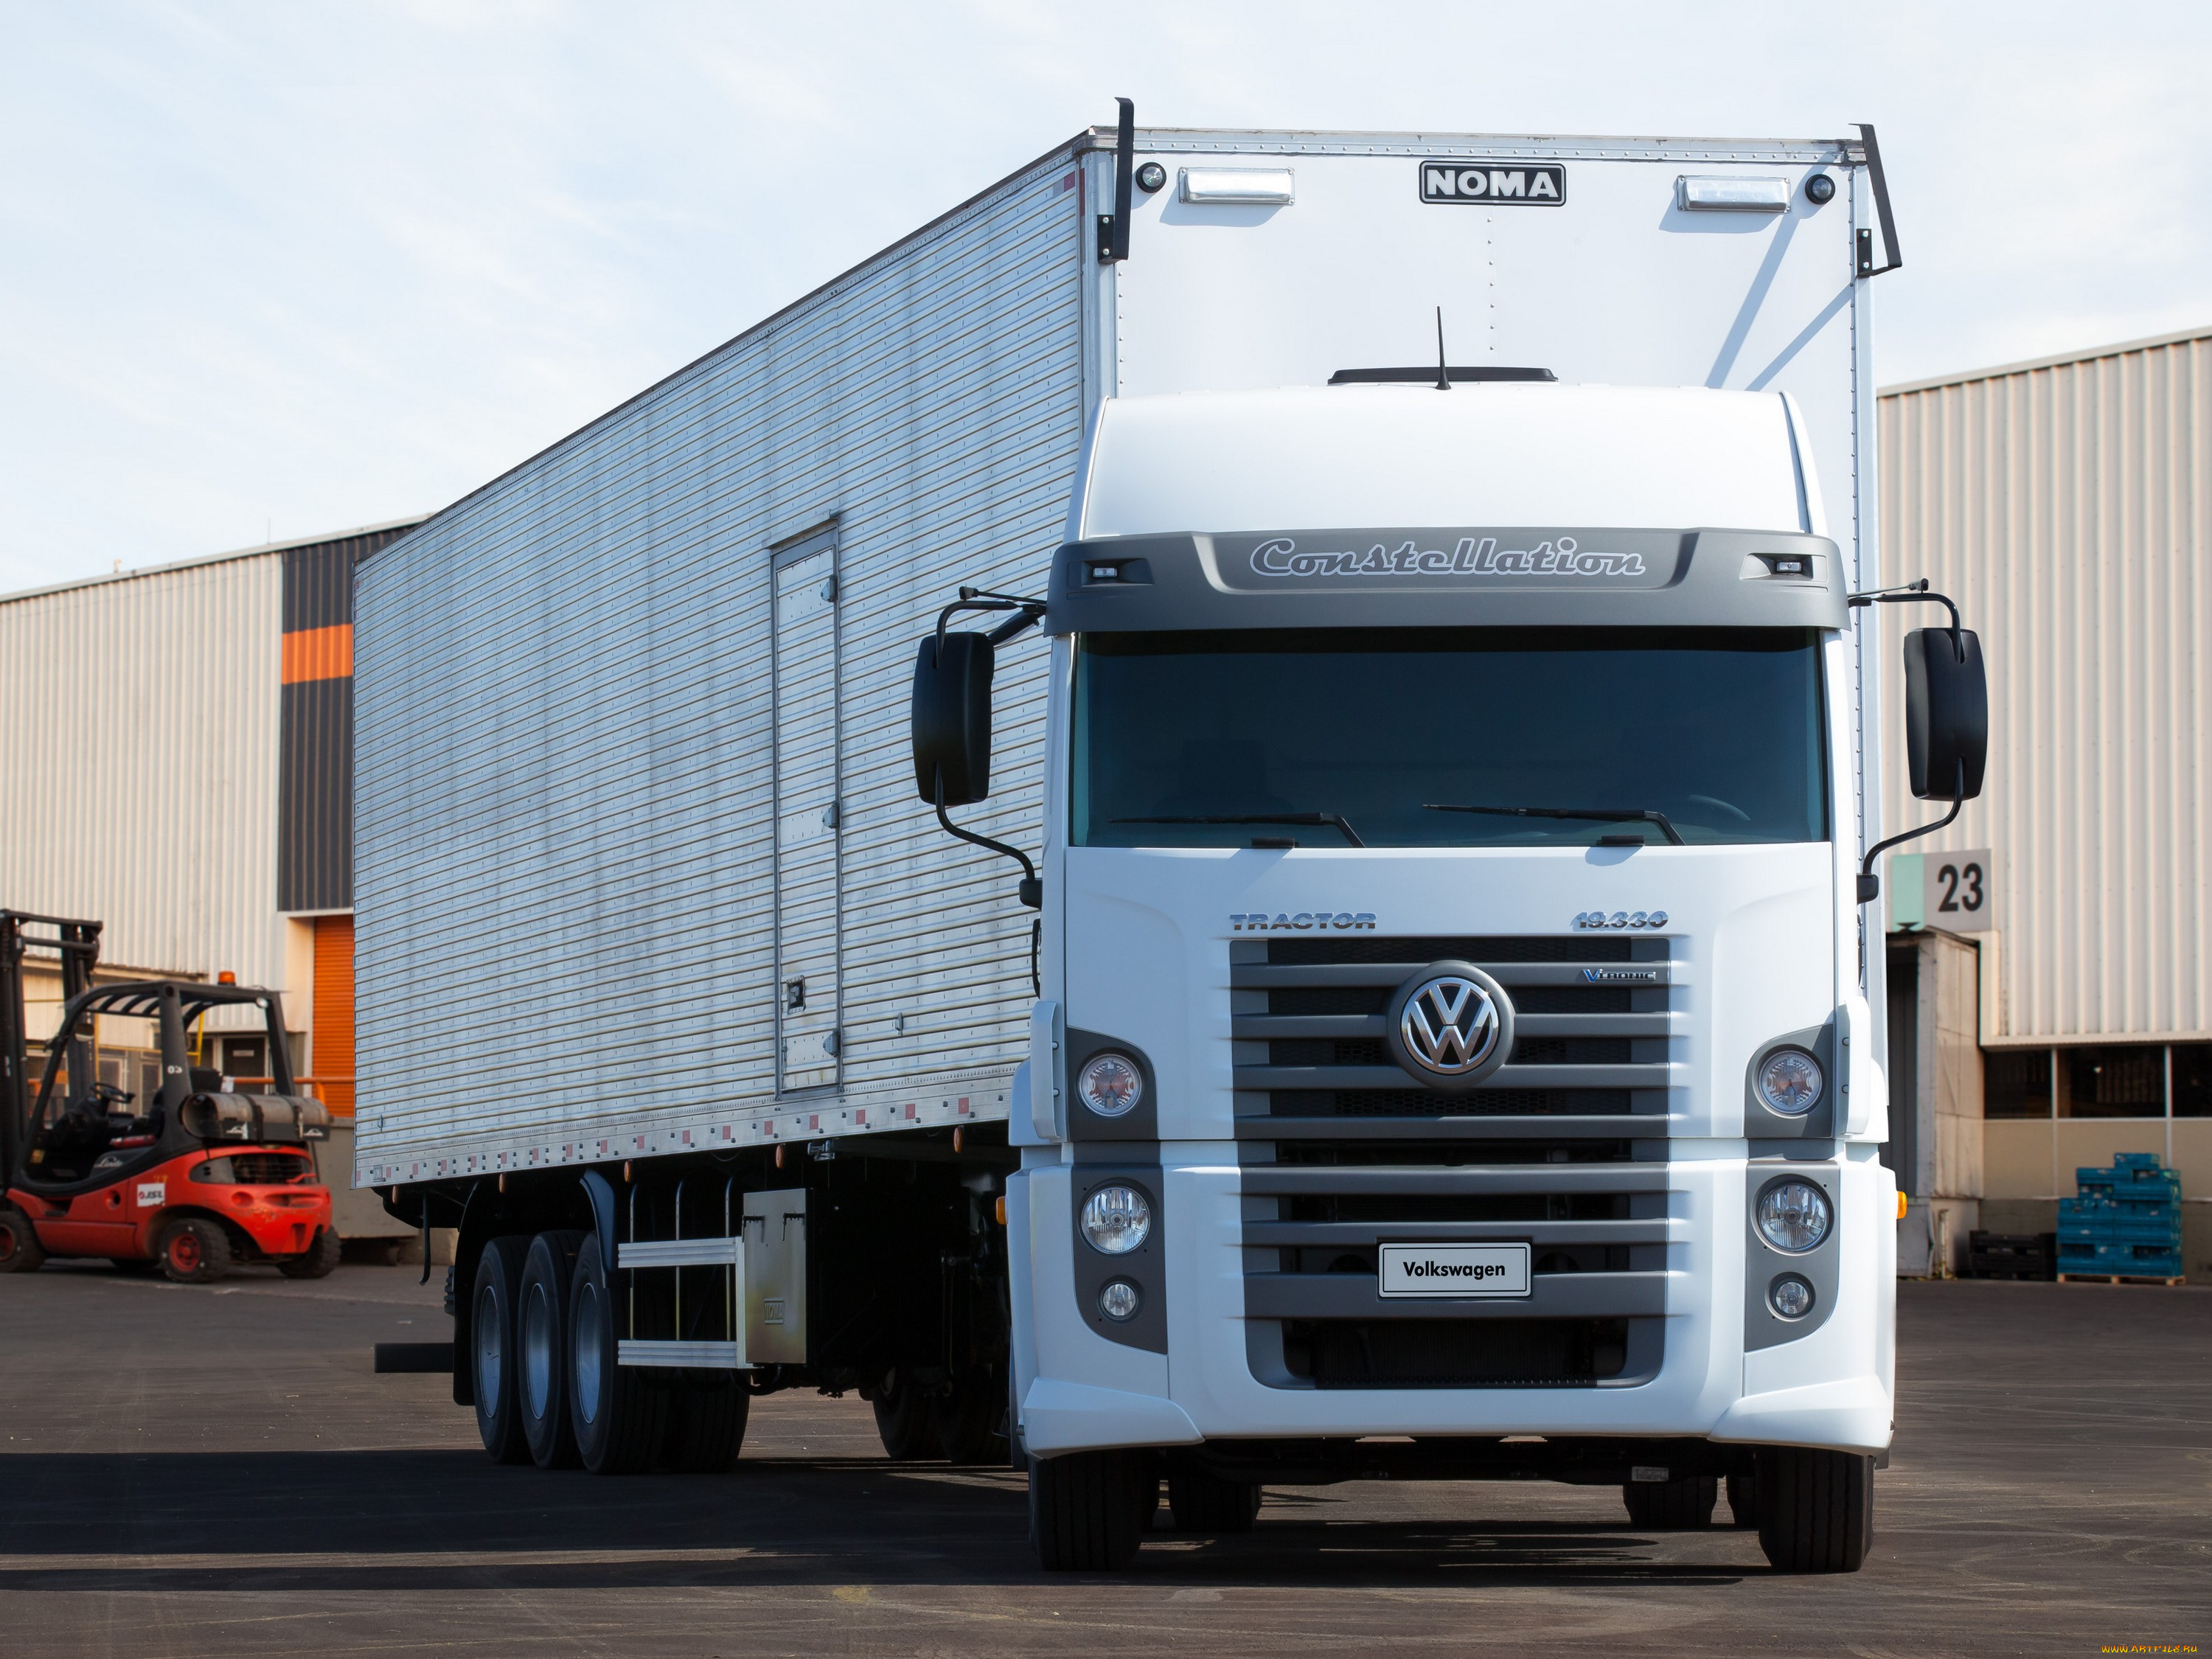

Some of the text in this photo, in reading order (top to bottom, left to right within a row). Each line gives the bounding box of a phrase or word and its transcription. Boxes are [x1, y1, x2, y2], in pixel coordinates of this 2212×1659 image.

[1426, 169, 1559, 198] NOMA
[1250, 537, 1646, 577] Constellation
[1937, 863, 1983, 912] 23
[1229, 912, 1377, 931] TRACTOR
[1576, 911, 1669, 928] 19.330
[1402, 977, 1498, 1074] VW
[1403, 1261, 1506, 1280] Volkswagen
